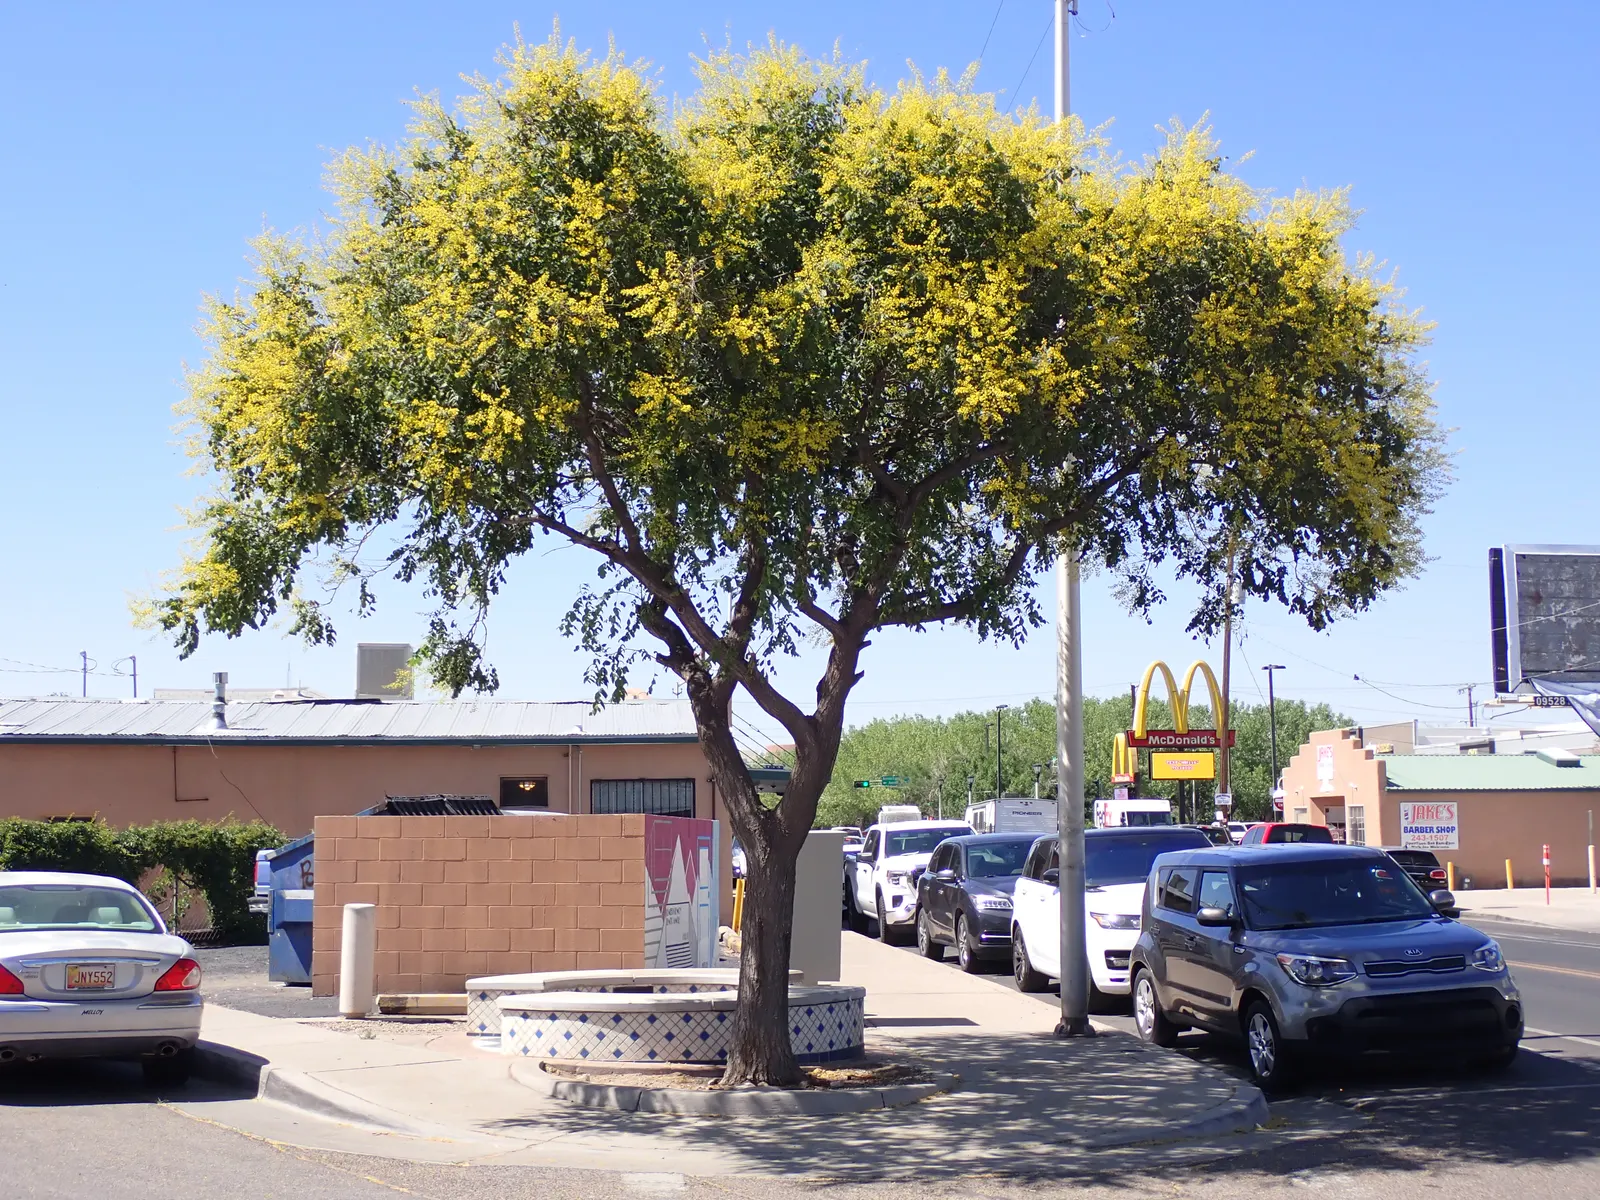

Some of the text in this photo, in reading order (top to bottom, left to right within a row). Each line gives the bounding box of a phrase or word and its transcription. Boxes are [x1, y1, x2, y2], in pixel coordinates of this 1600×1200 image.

[1148, 735, 1216, 745] McDonald's
[1410, 804, 1455, 824] JAKE'S
[1403, 826, 1456, 834] BARBER SHOP
[1411, 834, 1449, 842] 243-1507
[74, 971, 113, 983] JNY552
